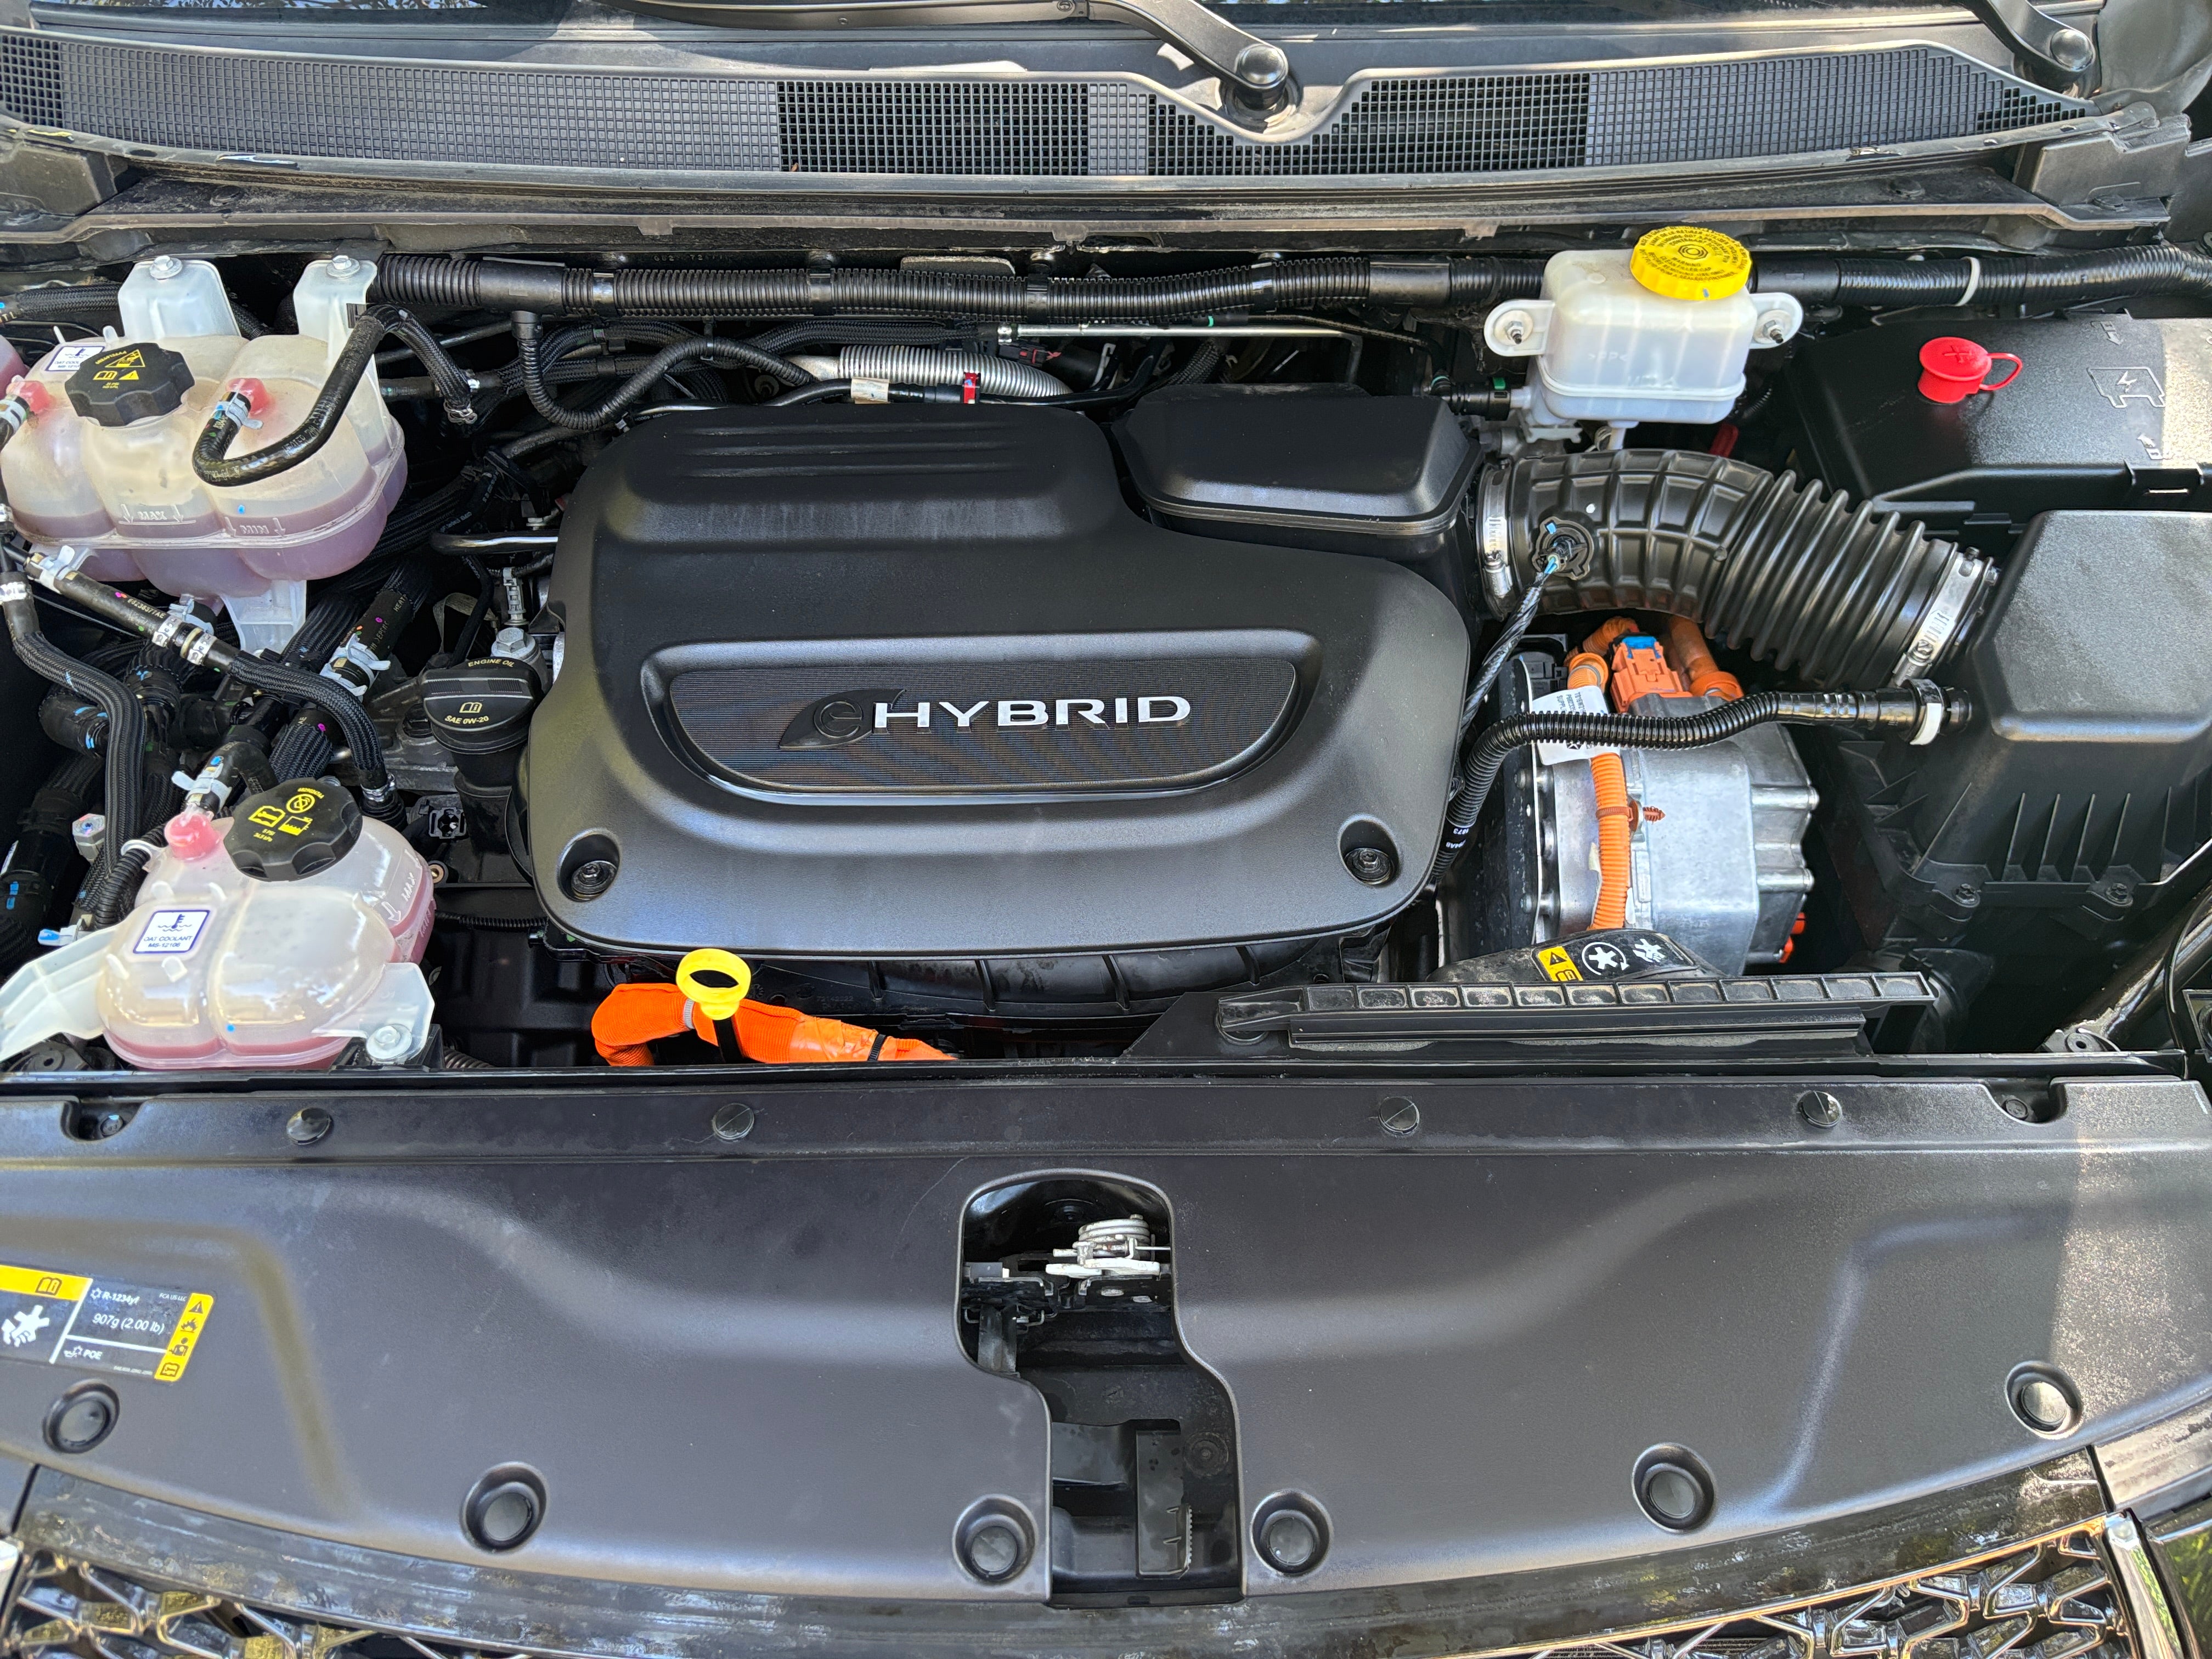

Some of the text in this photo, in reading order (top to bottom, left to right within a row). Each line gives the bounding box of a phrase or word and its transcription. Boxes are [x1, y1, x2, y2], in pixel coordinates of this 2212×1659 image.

[137, 511, 167, 521] MAX
[468, 659, 515, 668] ENGINE OIL
[444, 715, 489, 724] SAE 0W-20
[101, 1291, 140, 1305] R-1234yf
[92, 1313, 165, 1335] 907g (2.00 lb)
[83, 1350, 104, 1361] POE
